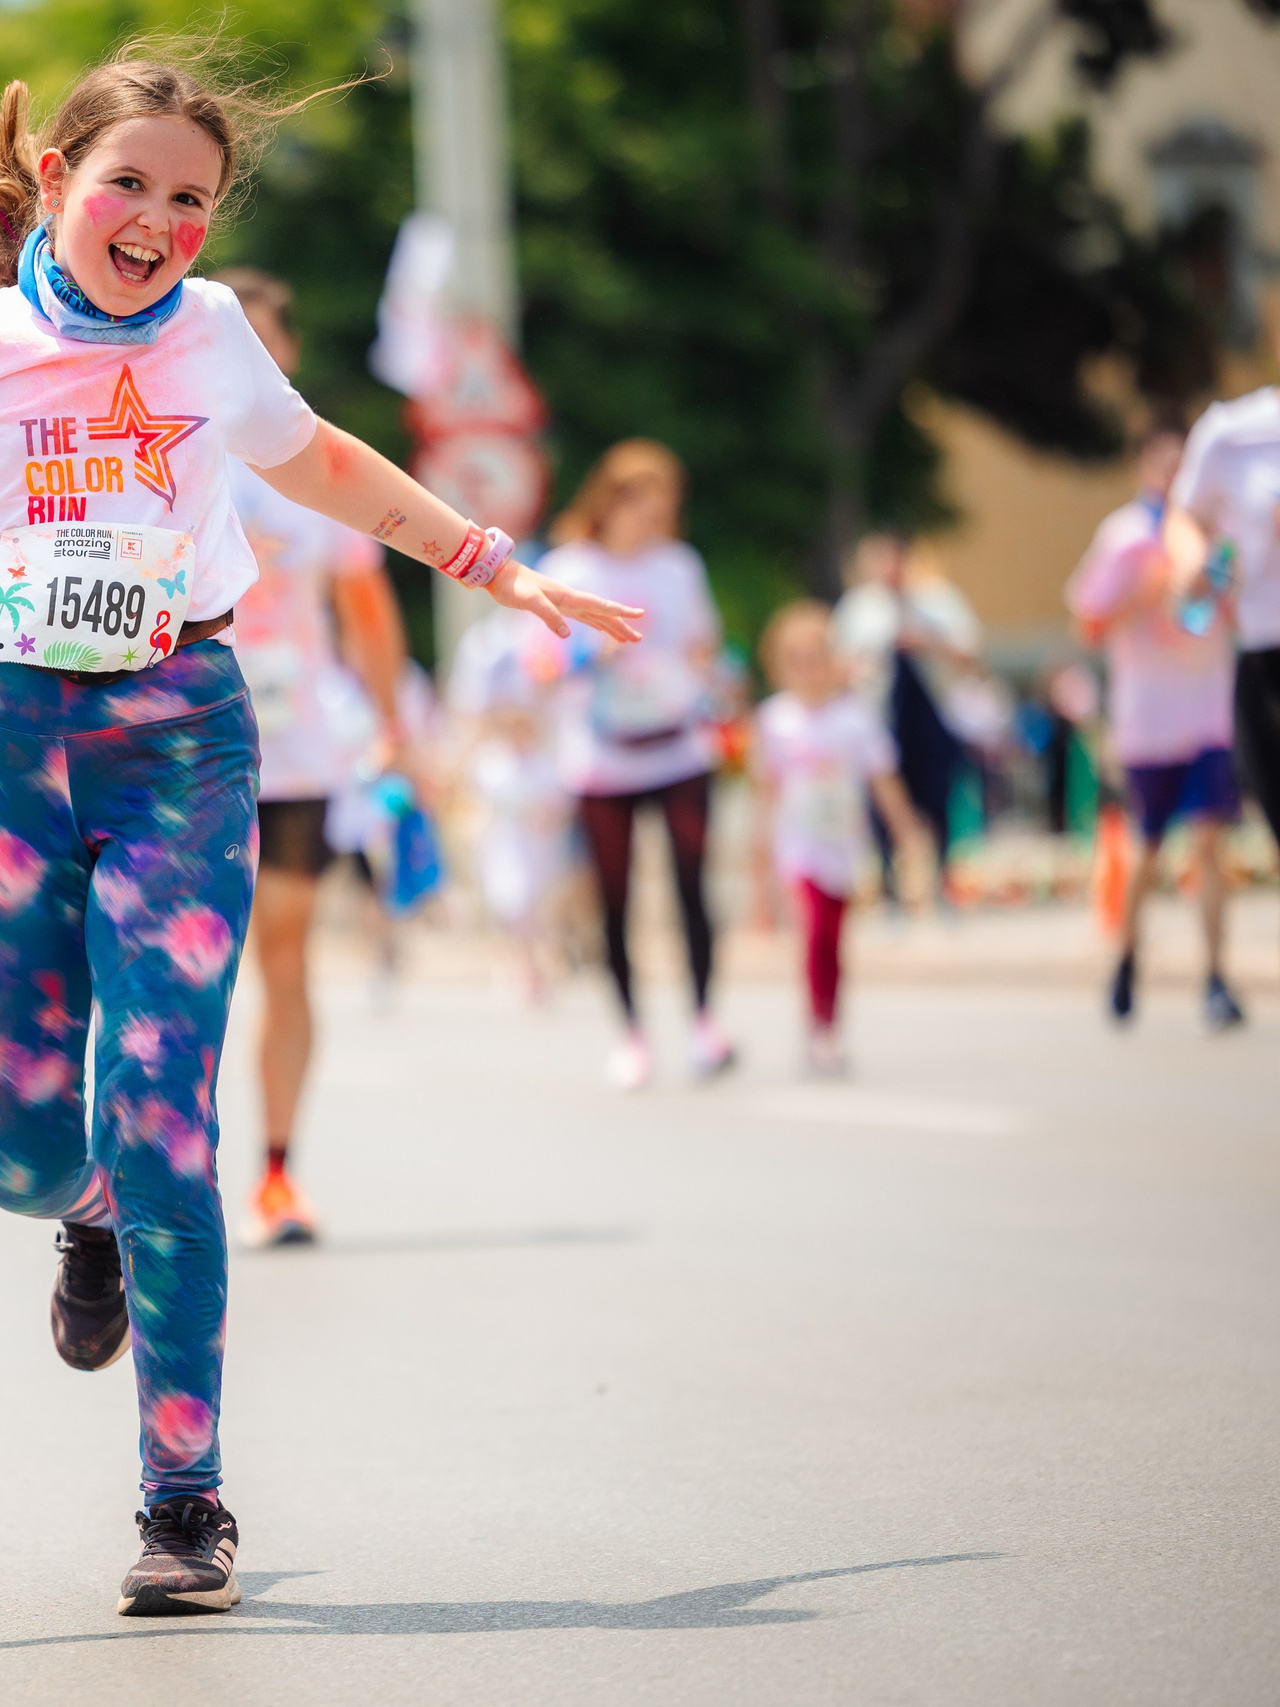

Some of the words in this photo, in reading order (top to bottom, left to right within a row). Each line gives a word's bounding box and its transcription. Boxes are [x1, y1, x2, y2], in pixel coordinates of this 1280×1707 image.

[19, 417, 78, 456] THE
[25, 456, 124, 496] COLOR
[54, 538, 111, 551] amazing
[56, 529, 70, 538] THE
[70, 528, 96, 538] COLOR
[62, 548, 88, 557] tour
[46, 576, 145, 639] 15489
